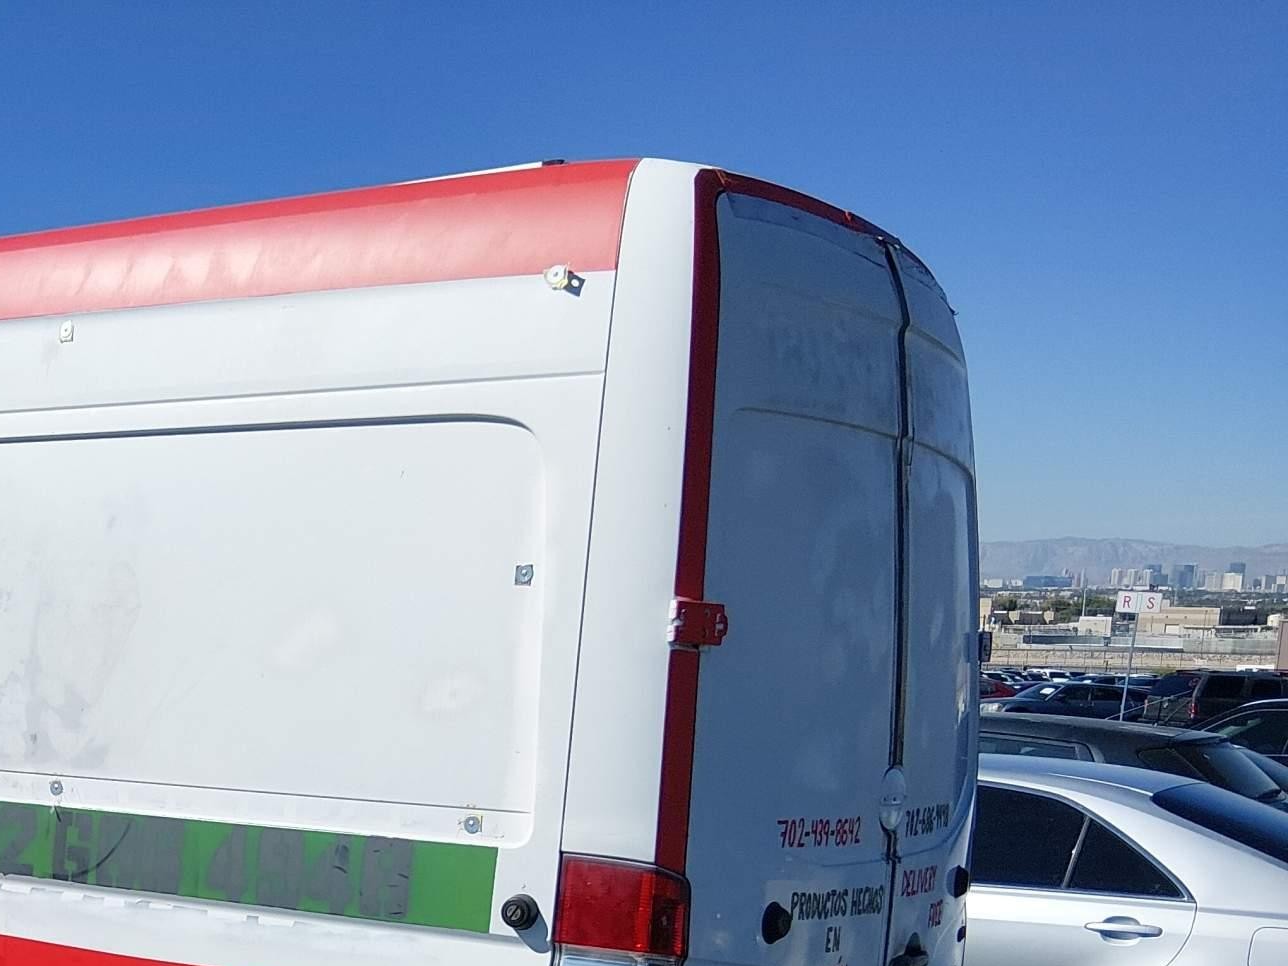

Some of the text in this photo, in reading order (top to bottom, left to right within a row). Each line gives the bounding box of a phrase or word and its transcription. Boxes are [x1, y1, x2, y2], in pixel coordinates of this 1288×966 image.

[1122, 595, 1155, 610] R S
[777, 815, 861, 849] 702-439-8642
[901, 864, 938, 897] DELIVERY
[790, 884, 884, 921] PRODUCTOS HECHOS
[825, 926, 841, 953] EN
